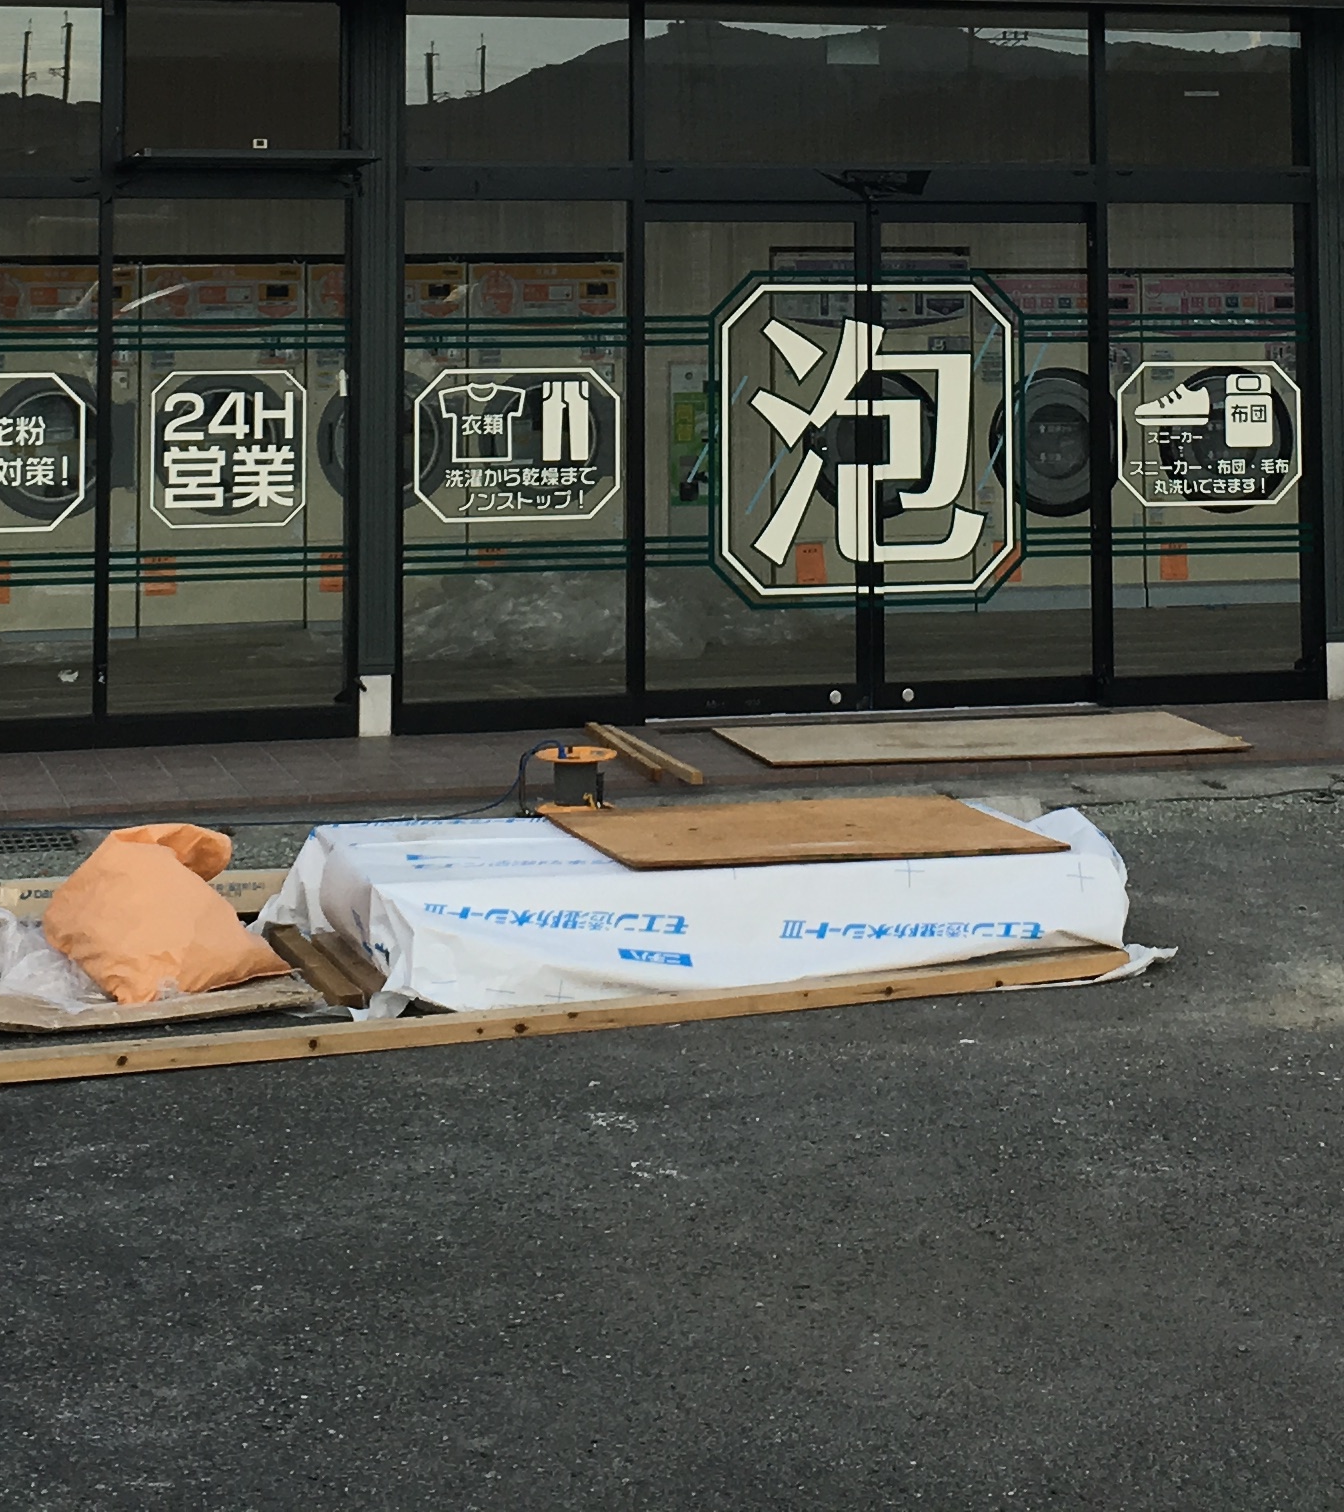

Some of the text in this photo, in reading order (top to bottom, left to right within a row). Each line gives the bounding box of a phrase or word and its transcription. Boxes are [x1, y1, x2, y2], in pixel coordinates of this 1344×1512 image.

[163, 391, 294, 441] 24H
[461, 413, 504, 436] 衣類
[1230, 404, 1268, 424] 布団
[746, 316, 988, 568] 泡
[1147, 431, 1203, 444] スニーカー
[162, 445, 296, 509] 営業
[445, 466, 598, 488] 洗濯から乾燥まで
[1129, 458, 1289, 476] スニーカー・布団・毛布
[1154, 477, 1266, 495] 丸洗いできます！
[458, 489, 584, 512] ノンストップ！
